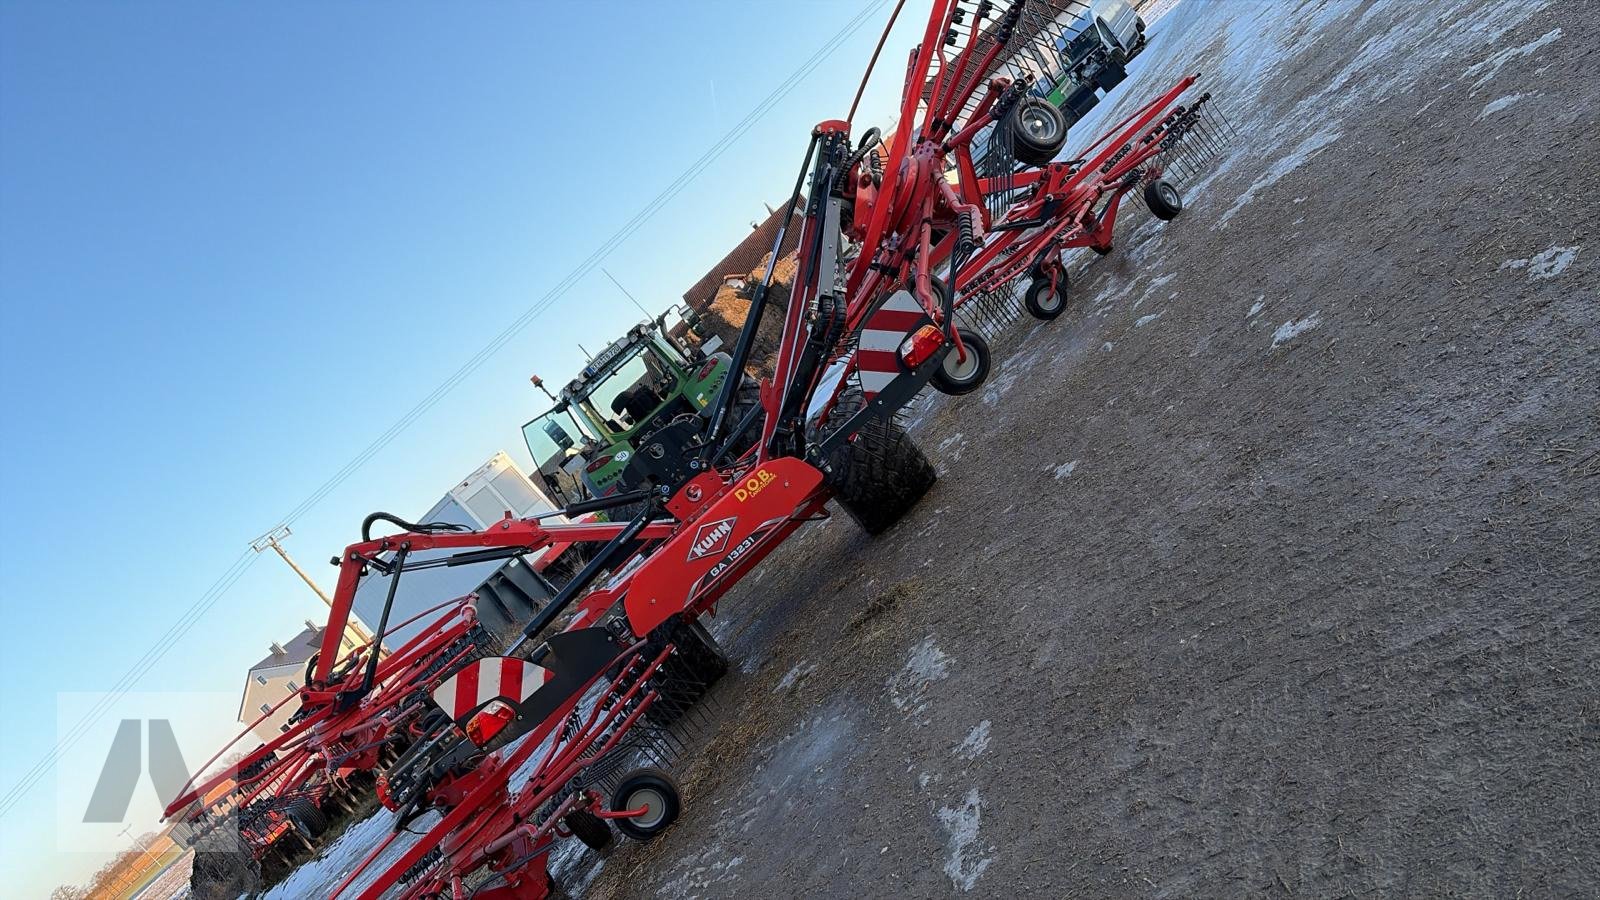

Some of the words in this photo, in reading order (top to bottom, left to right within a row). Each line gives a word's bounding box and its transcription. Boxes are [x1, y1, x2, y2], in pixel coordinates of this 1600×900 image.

[692, 521, 732, 557] KUHN
[710, 562, 727, 577] GA
[727, 536, 755, 561] 13231
